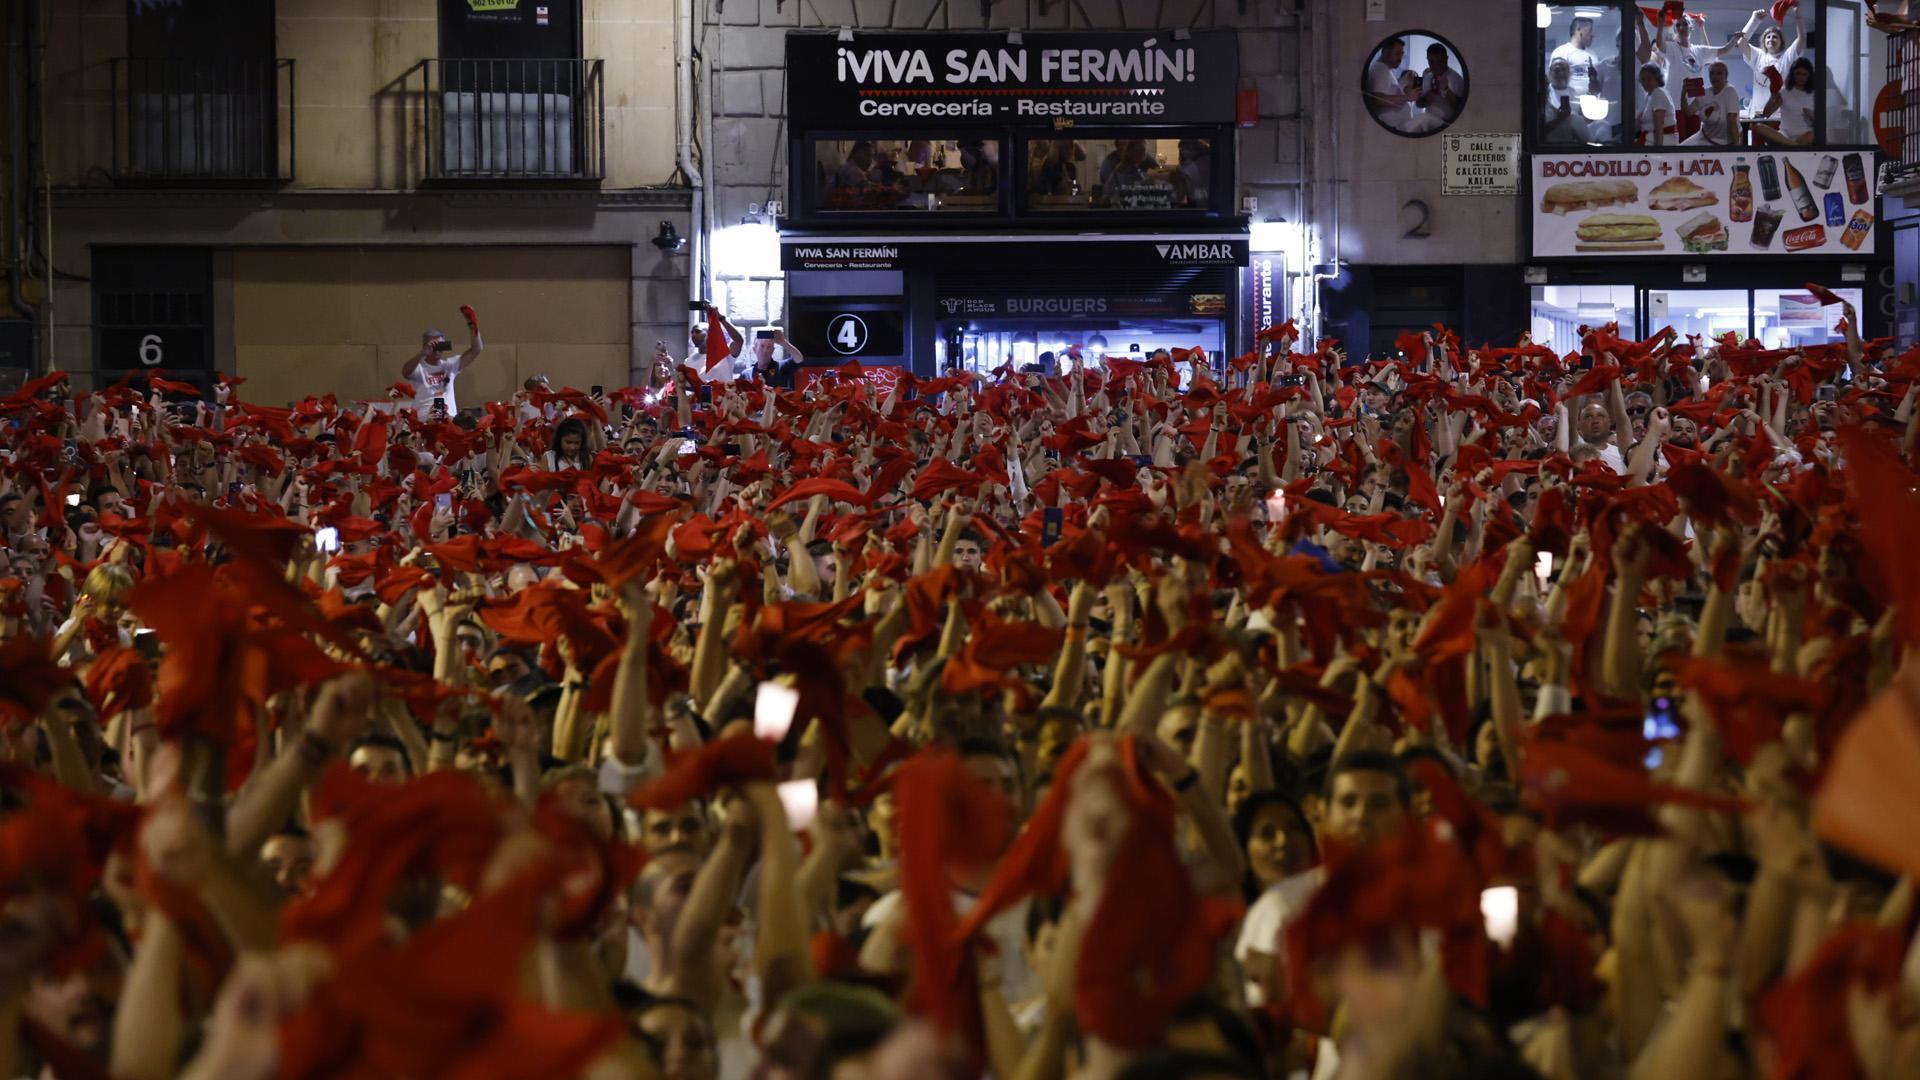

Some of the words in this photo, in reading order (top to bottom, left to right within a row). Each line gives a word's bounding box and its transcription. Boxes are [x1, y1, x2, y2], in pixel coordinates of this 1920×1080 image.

[945, 49, 1027, 83] SAN
[1041, 38, 1195, 83] FERMÍN!
[859, 98, 993, 116] Cervecería
[1018, 99, 1165, 116] Restaurante
[1470, 142, 1493, 151] CALLE
[1458, 153, 1506, 162] CALCETEROS
[1456, 167, 1509, 176] CALCETEROS
[1543, 160, 1652, 177] BOCADILLO
[1679, 159, 1725, 176] LATA
[1468, 177, 1494, 185] KALEA
[1401, 199, 1433, 240] 2
[826, 248, 850, 258] SAN
[853, 246, 898, 258] FERMÍN!
[1170, 244, 1234, 259] AMBAR
[1007, 298, 1107, 313] BURGUERS
[837, 320, 858, 348] 4
[139, 334, 163, 365] 6
